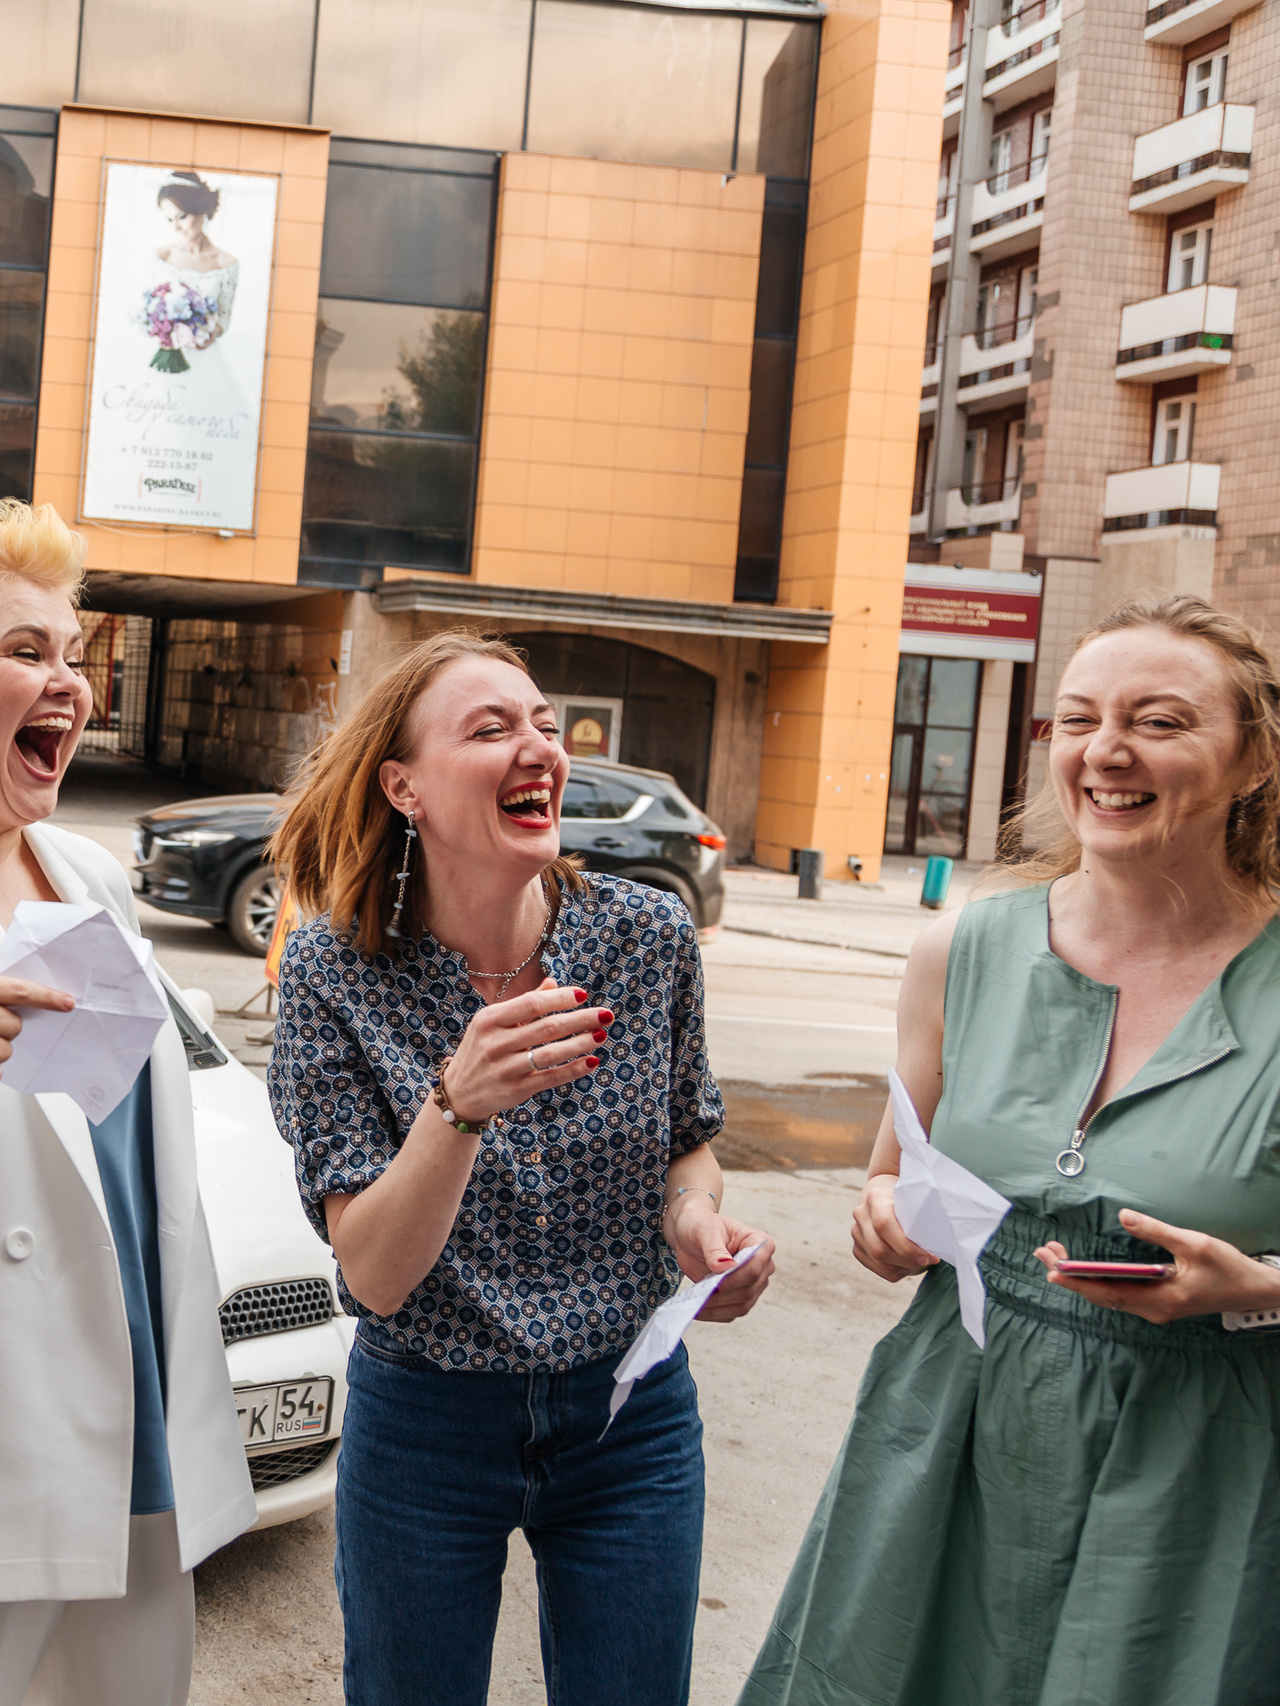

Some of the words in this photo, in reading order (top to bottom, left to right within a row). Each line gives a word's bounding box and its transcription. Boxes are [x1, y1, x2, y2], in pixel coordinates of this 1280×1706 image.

[141, 446, 160, 457] 913
[163, 448, 183, 458] 770
[185, 450, 198, 460] 18
[200, 451, 213, 461] 62
[147, 459, 198, 471] 222-15-87
[144, 478, 196, 494] PARADISE
[280, 1386, 315, 1419] 54
[276, 1420, 301, 1433] RUS
